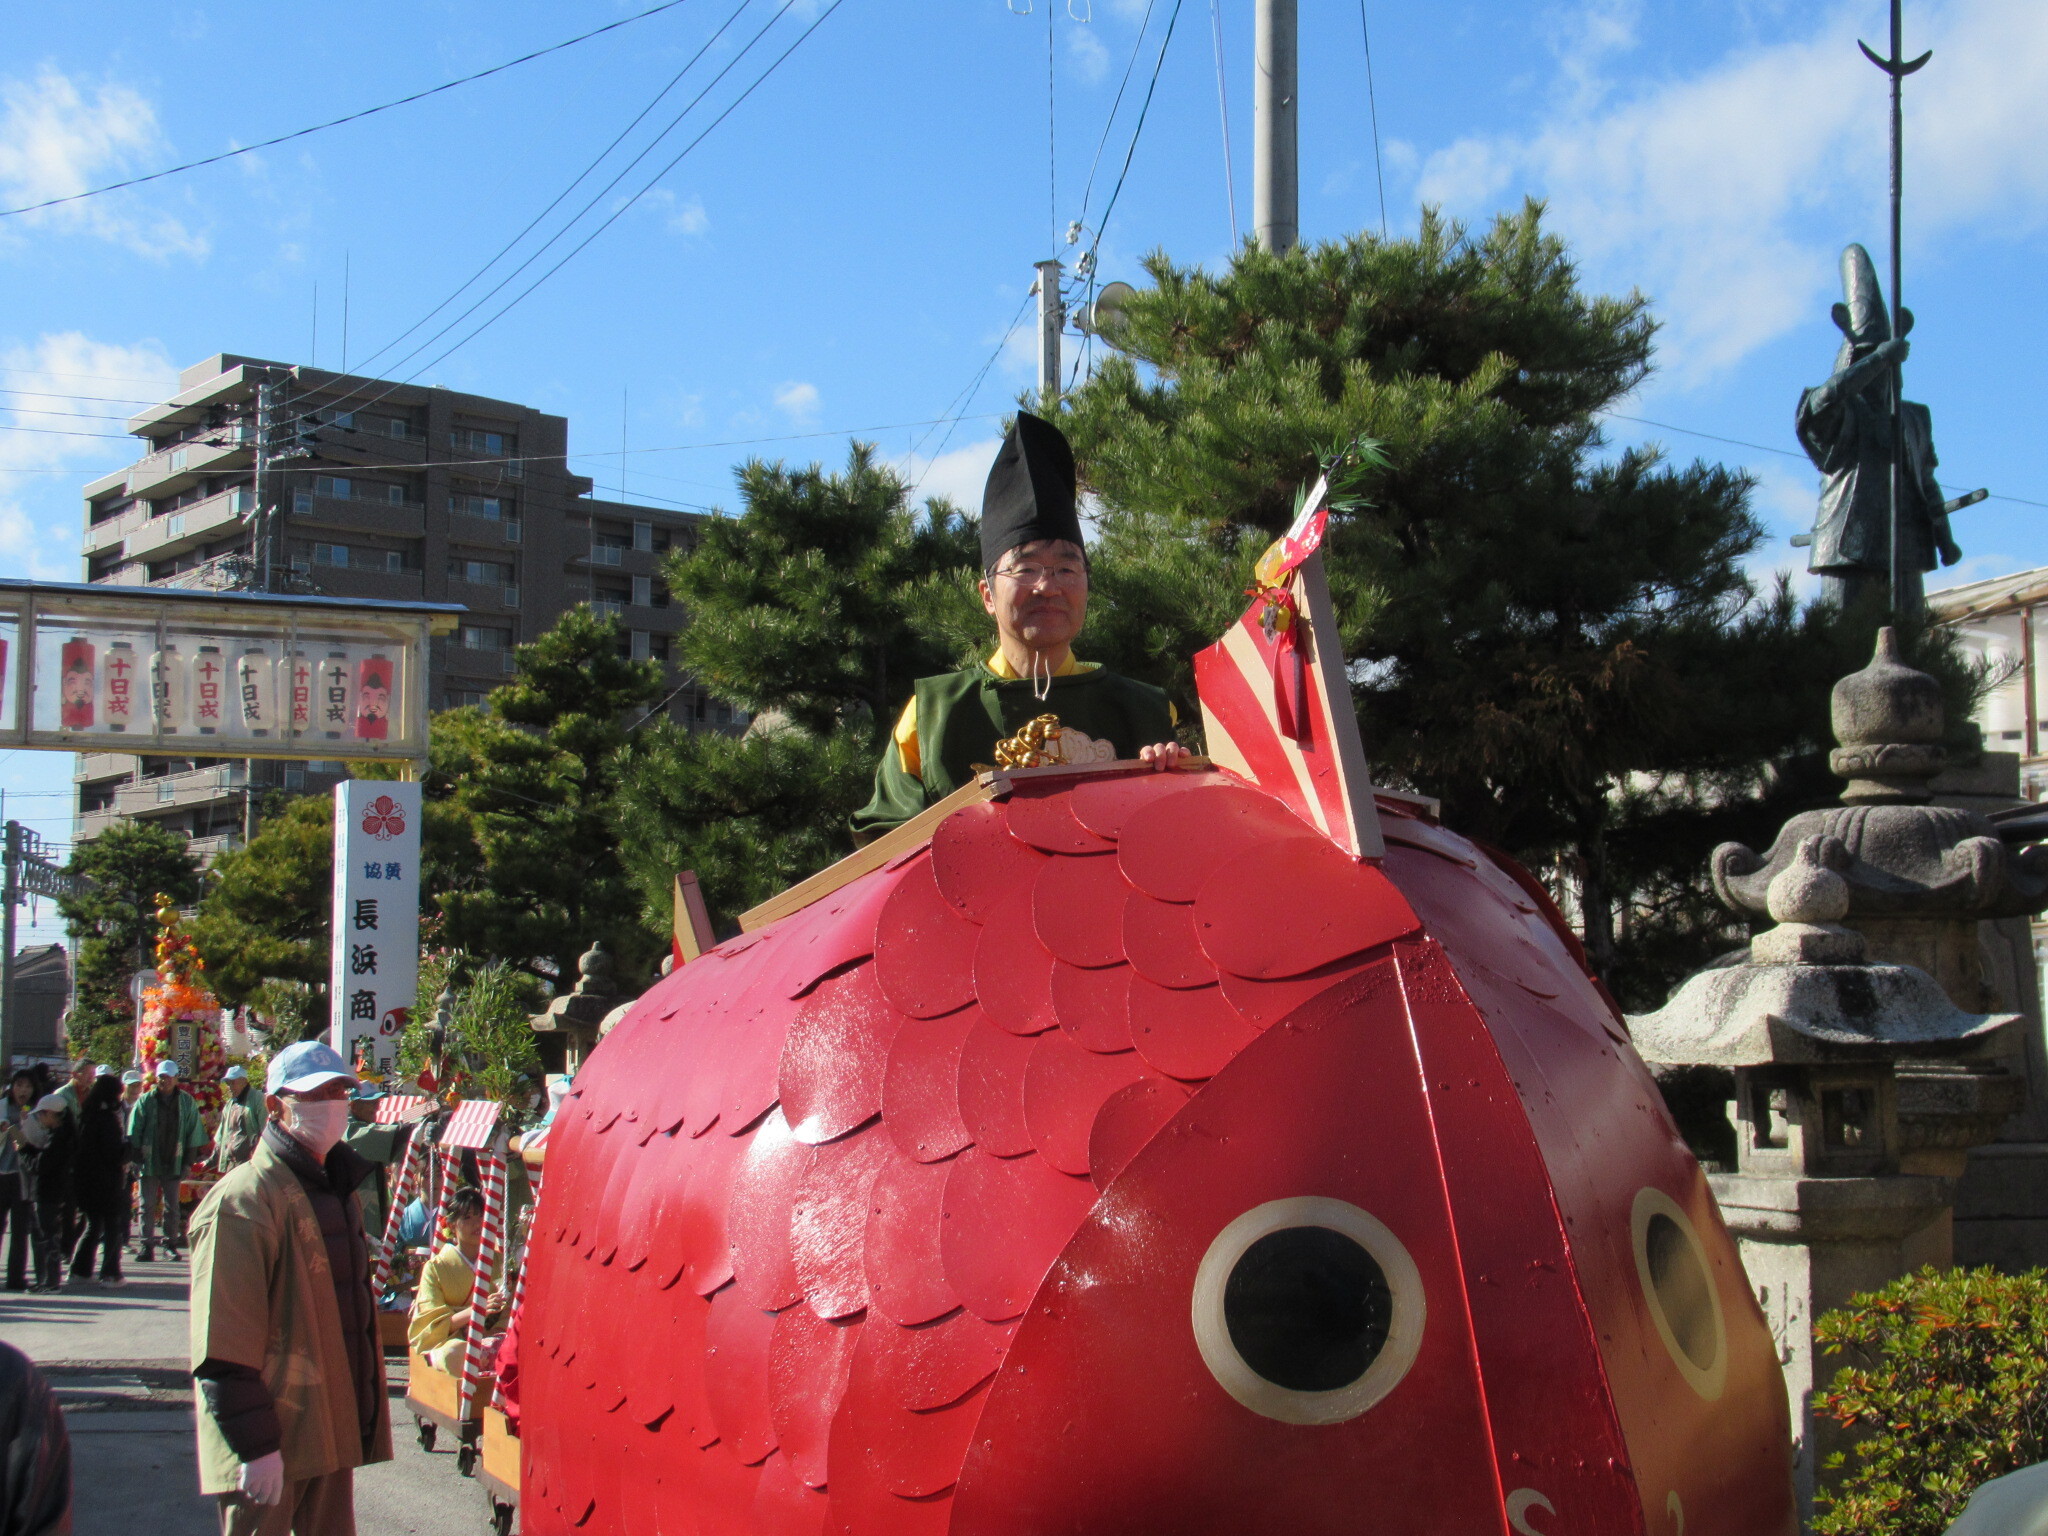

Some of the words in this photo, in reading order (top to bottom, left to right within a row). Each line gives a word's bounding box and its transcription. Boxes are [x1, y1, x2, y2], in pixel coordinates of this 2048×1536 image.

[108, 658, 131, 715] 十日戎
[198, 661, 220, 719] 十日戎
[240, 664, 260, 720] 十日戎
[326, 666, 347, 723] 十日戎
